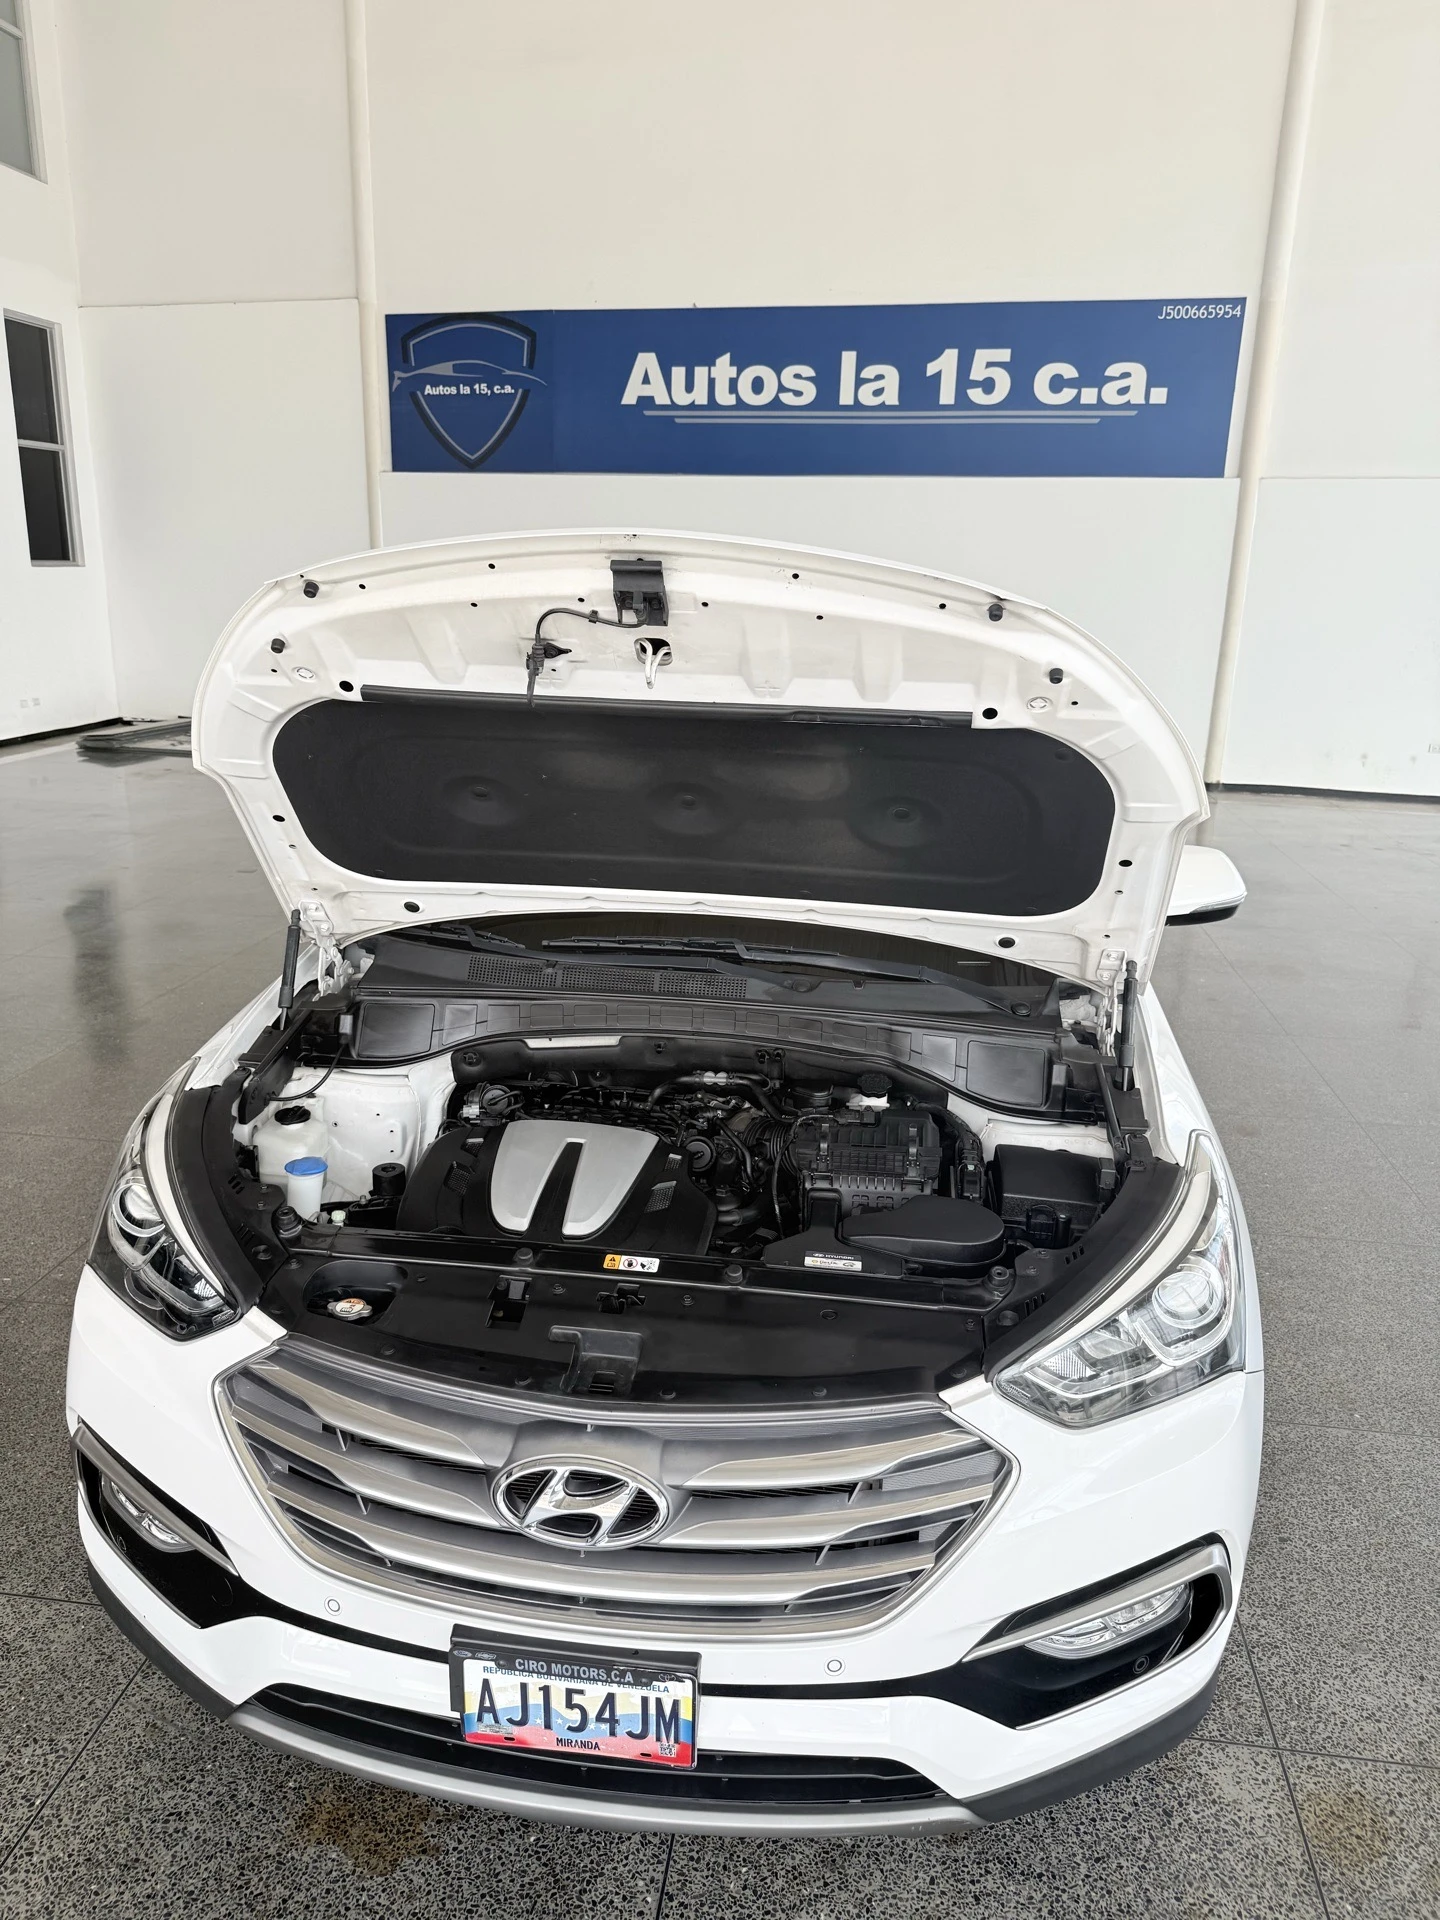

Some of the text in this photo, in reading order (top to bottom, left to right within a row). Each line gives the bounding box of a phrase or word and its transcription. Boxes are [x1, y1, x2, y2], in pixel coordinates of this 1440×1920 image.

[1158, 304, 1242, 320] J500665954
[620, 348, 1168, 407] Autos la 15 c.a.
[424, 383, 515, 397] Autos la 15, c.a.
[515, 1658, 547, 1673] CIRO
[476, 1678, 681, 1744] AJ154JM
[556, 1737, 600, 1751] MIRANDA
